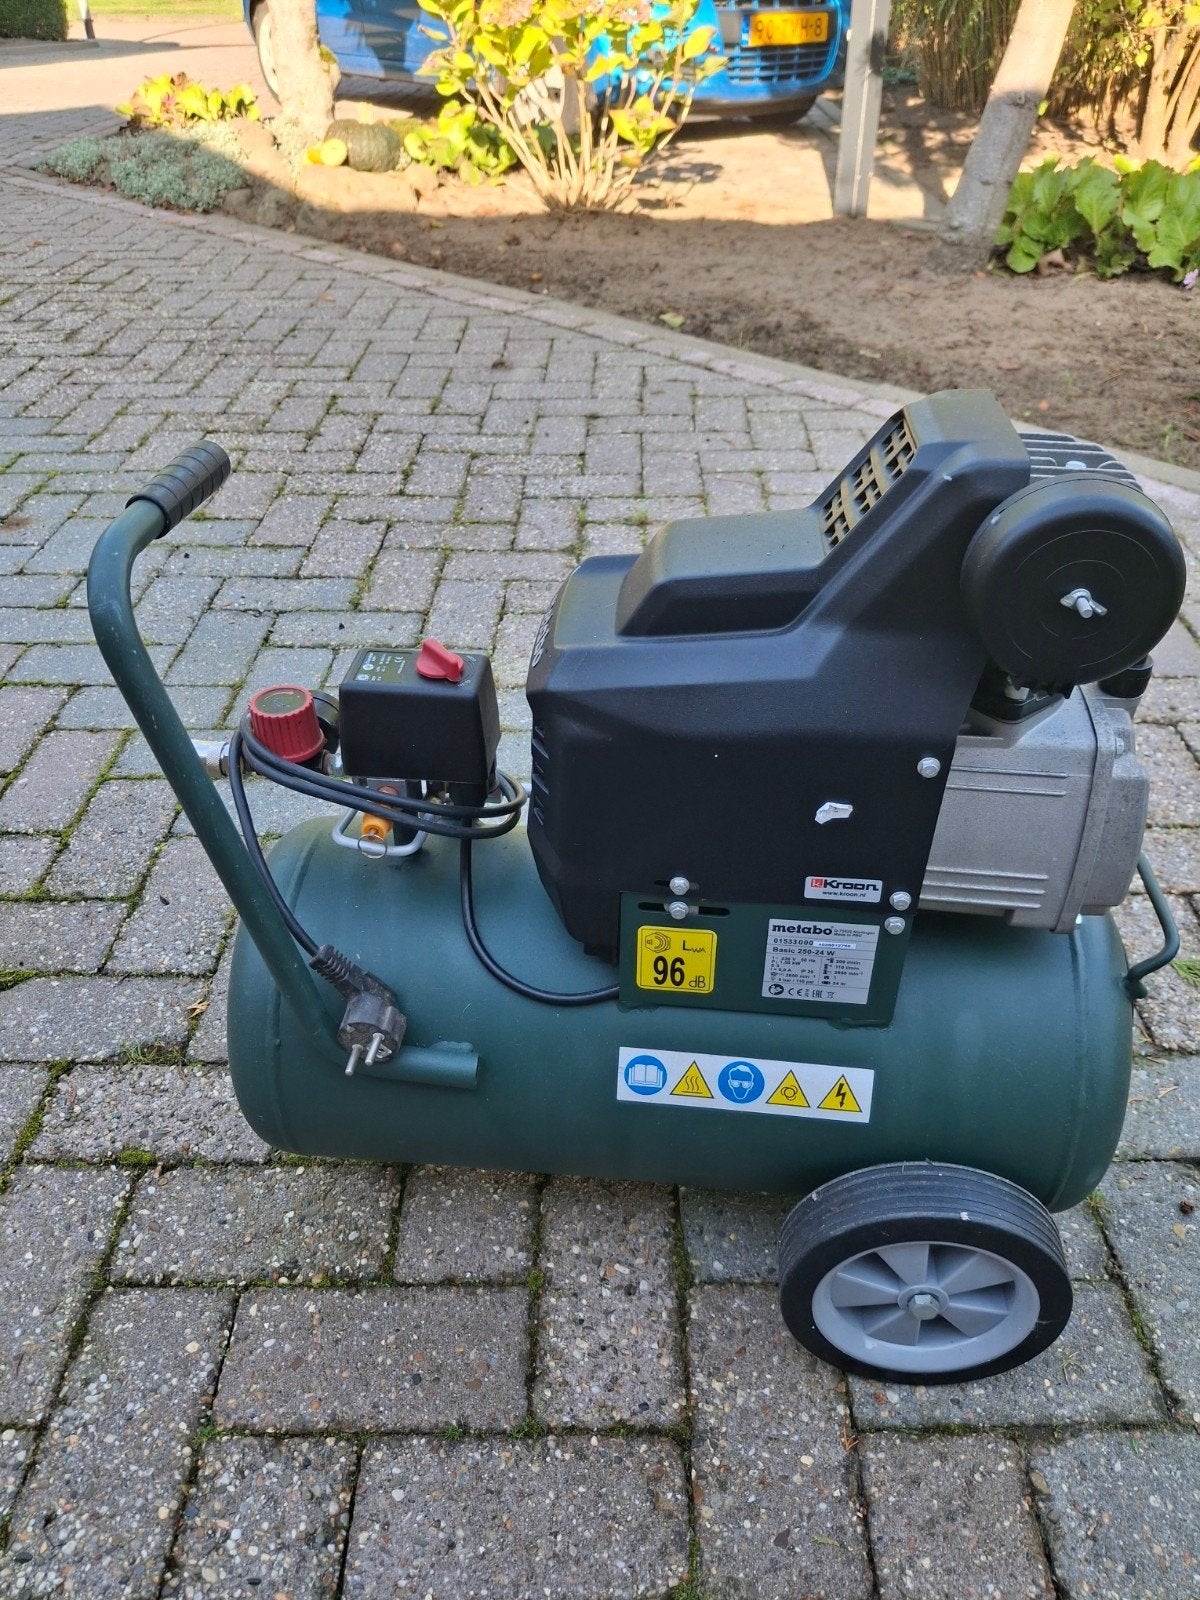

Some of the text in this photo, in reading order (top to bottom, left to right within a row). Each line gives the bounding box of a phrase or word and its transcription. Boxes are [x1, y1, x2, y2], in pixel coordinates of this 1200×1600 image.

[823, 880, 879, 891] Kroon
[772, 924, 833, 936] metabo
[773, 938, 814, 946] 01533000
[797, 948, 824, 956] 250-24
[653, 955, 685, 987] 96
[688, 975, 706, 989] dB
